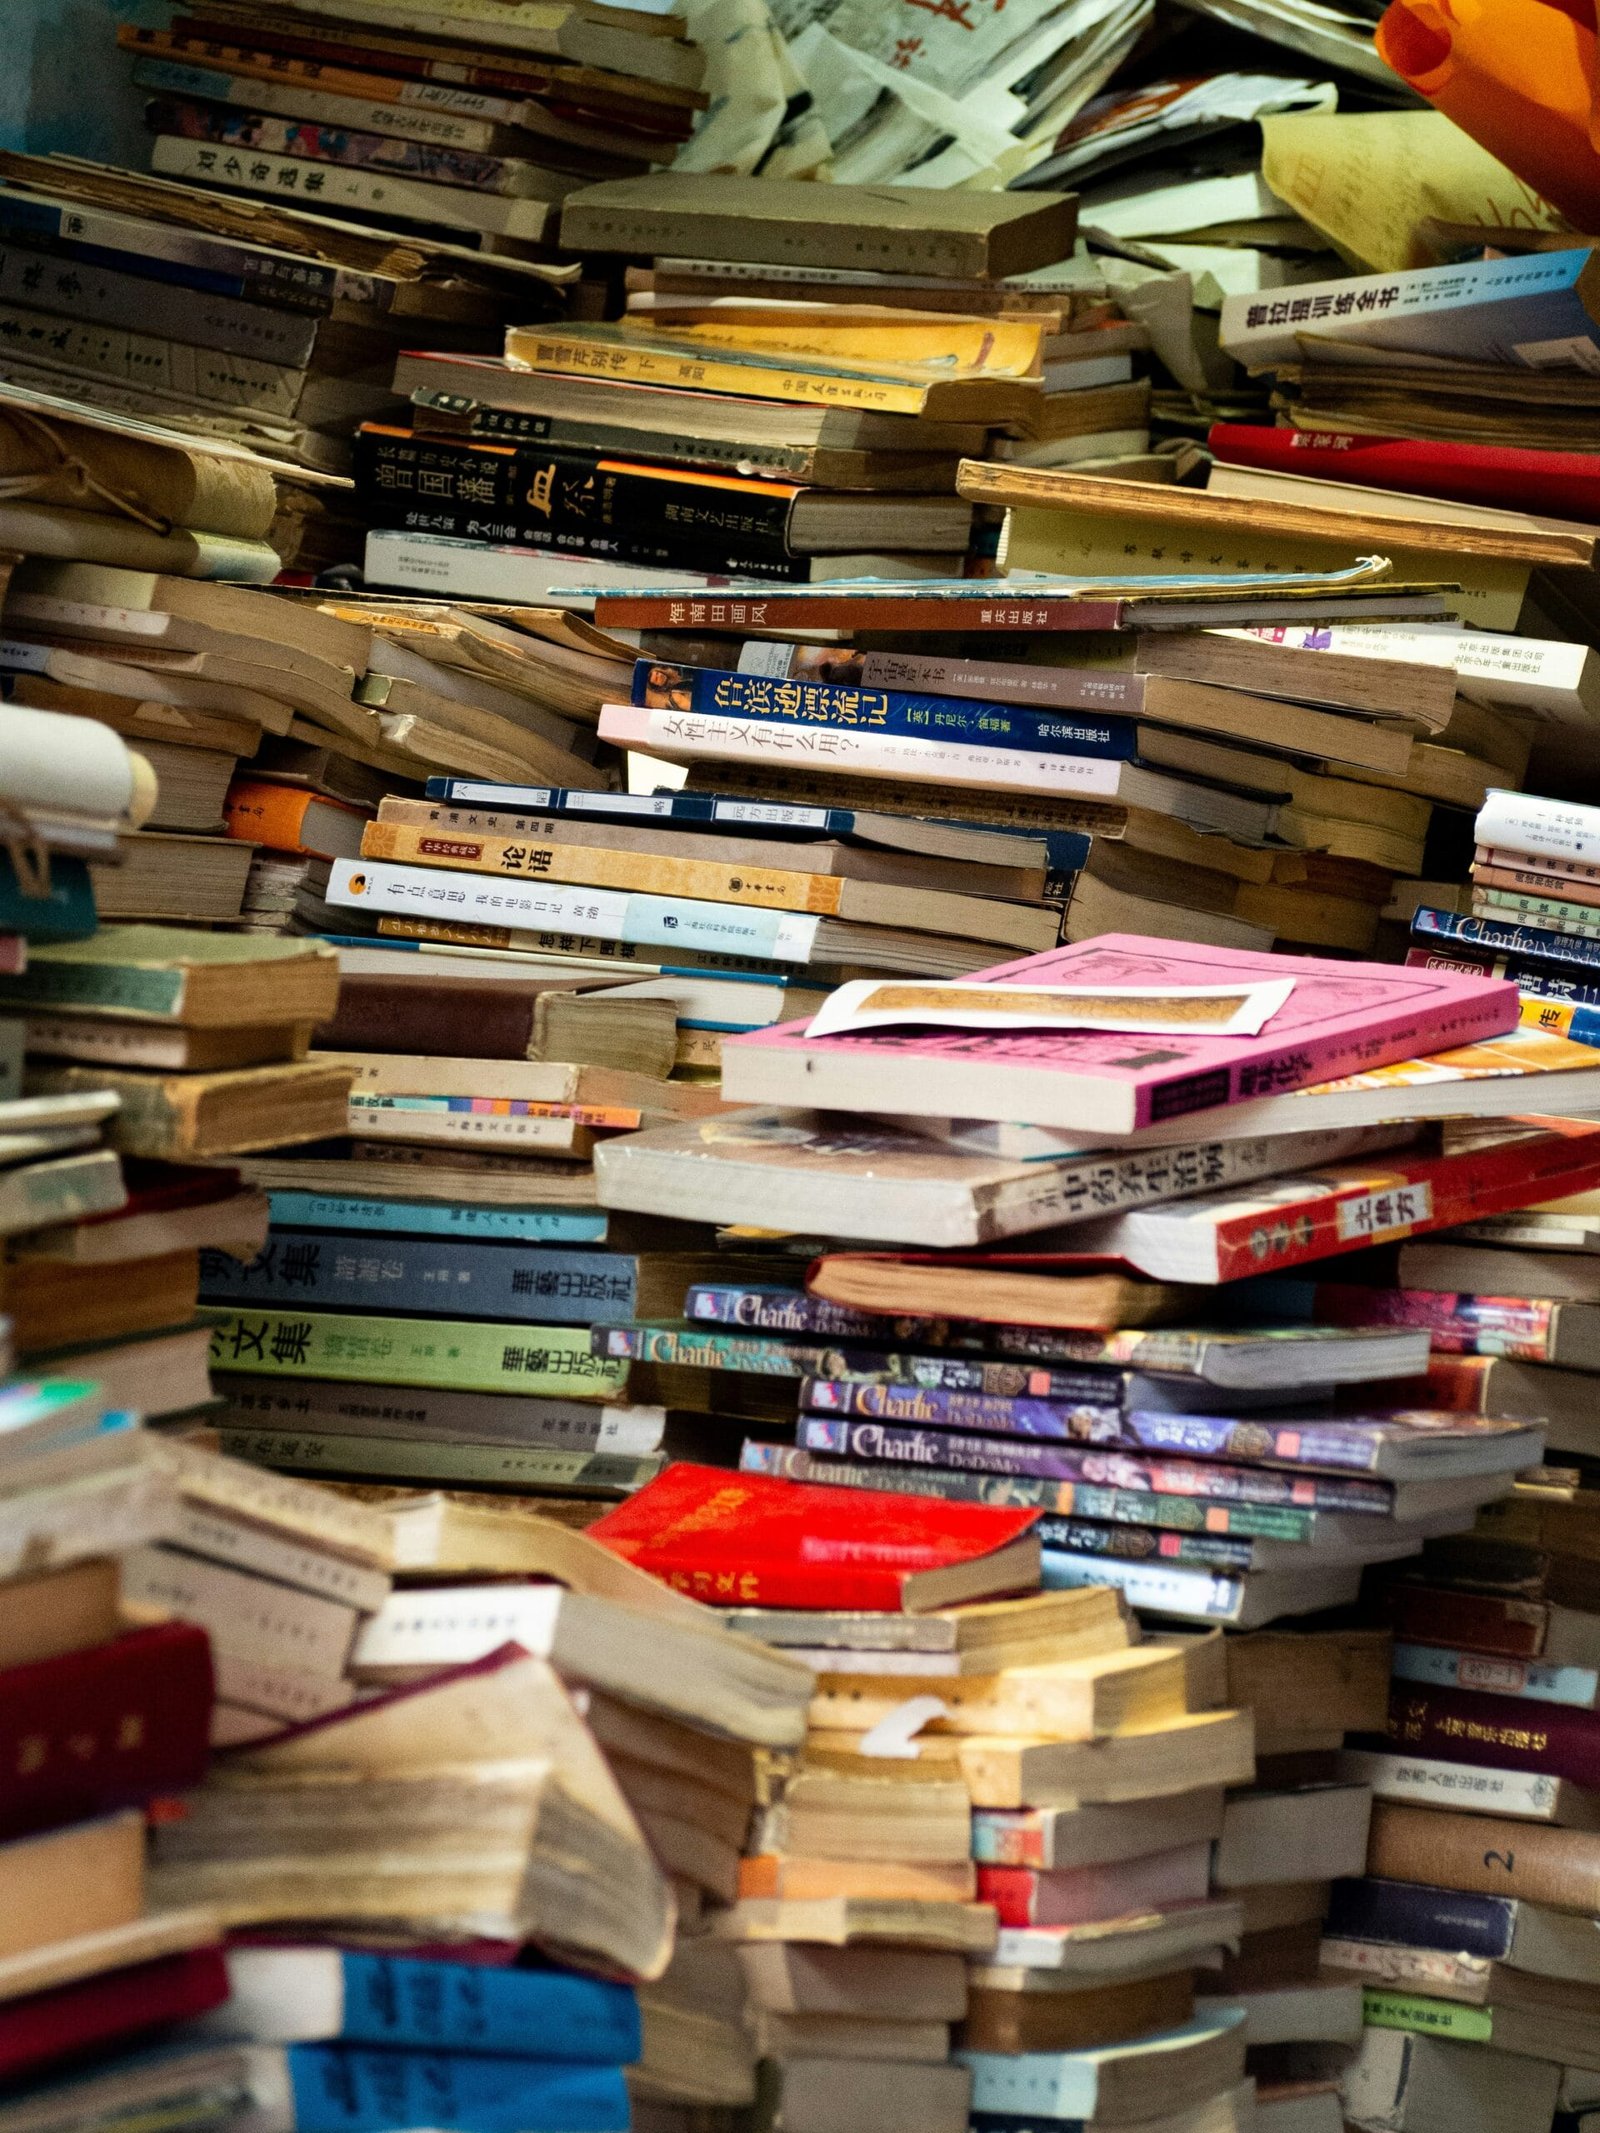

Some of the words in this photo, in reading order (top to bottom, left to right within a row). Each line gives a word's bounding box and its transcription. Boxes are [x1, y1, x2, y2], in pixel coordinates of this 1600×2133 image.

[196, 149, 326, 192] 刘少奇选集
[1248, 287, 1400, 328] 普拉提训练全书
[639, 355, 656, 374] 下
[376, 447, 500, 475] 长篇历史小说
[374, 460, 497, 505] 曾国藩
[664, 502, 771, 536] 湖南文艺出版社
[669, 601, 768, 627] 恽南田画风
[979, 608, 1049, 627] 重庆出版社
[866, 656, 946, 688] 宇宙最后一本书
[1454, 653, 1541, 675] 北京少年儿童出版社
[713, 677, 888, 727] 鲁滨逊漂流记
[1038, 722, 1112, 745] 哈尔滨出版社
[429, 810, 498, 832] 青浦文史
[515, 819, 556, 836] 第四期
[732, 804, 813, 828] 远方出版社
[422, 839, 479, 858] 中华经典藏书
[500, 844, 554, 874] 论语
[1514, 872, 1565, 891] 阅读和欣赏
[387, 882, 466, 906] 有点意思
[475, 893, 564, 915] 我的电影日记
[573, 904, 600, 920] 黄渤
[538, 931, 636, 959] 怎样下围棋
[1456, 917, 1534, 951] Charlie
[686, 1039, 716, 1053] 人民
[733, 1294, 809, 1332] Charlie
[649, 1332, 729, 1367] Charlie
[854, 1383, 939, 1421] Charlie
[851, 1424, 941, 1464] Charlie
[1483, 1848, 1516, 1874] 2
